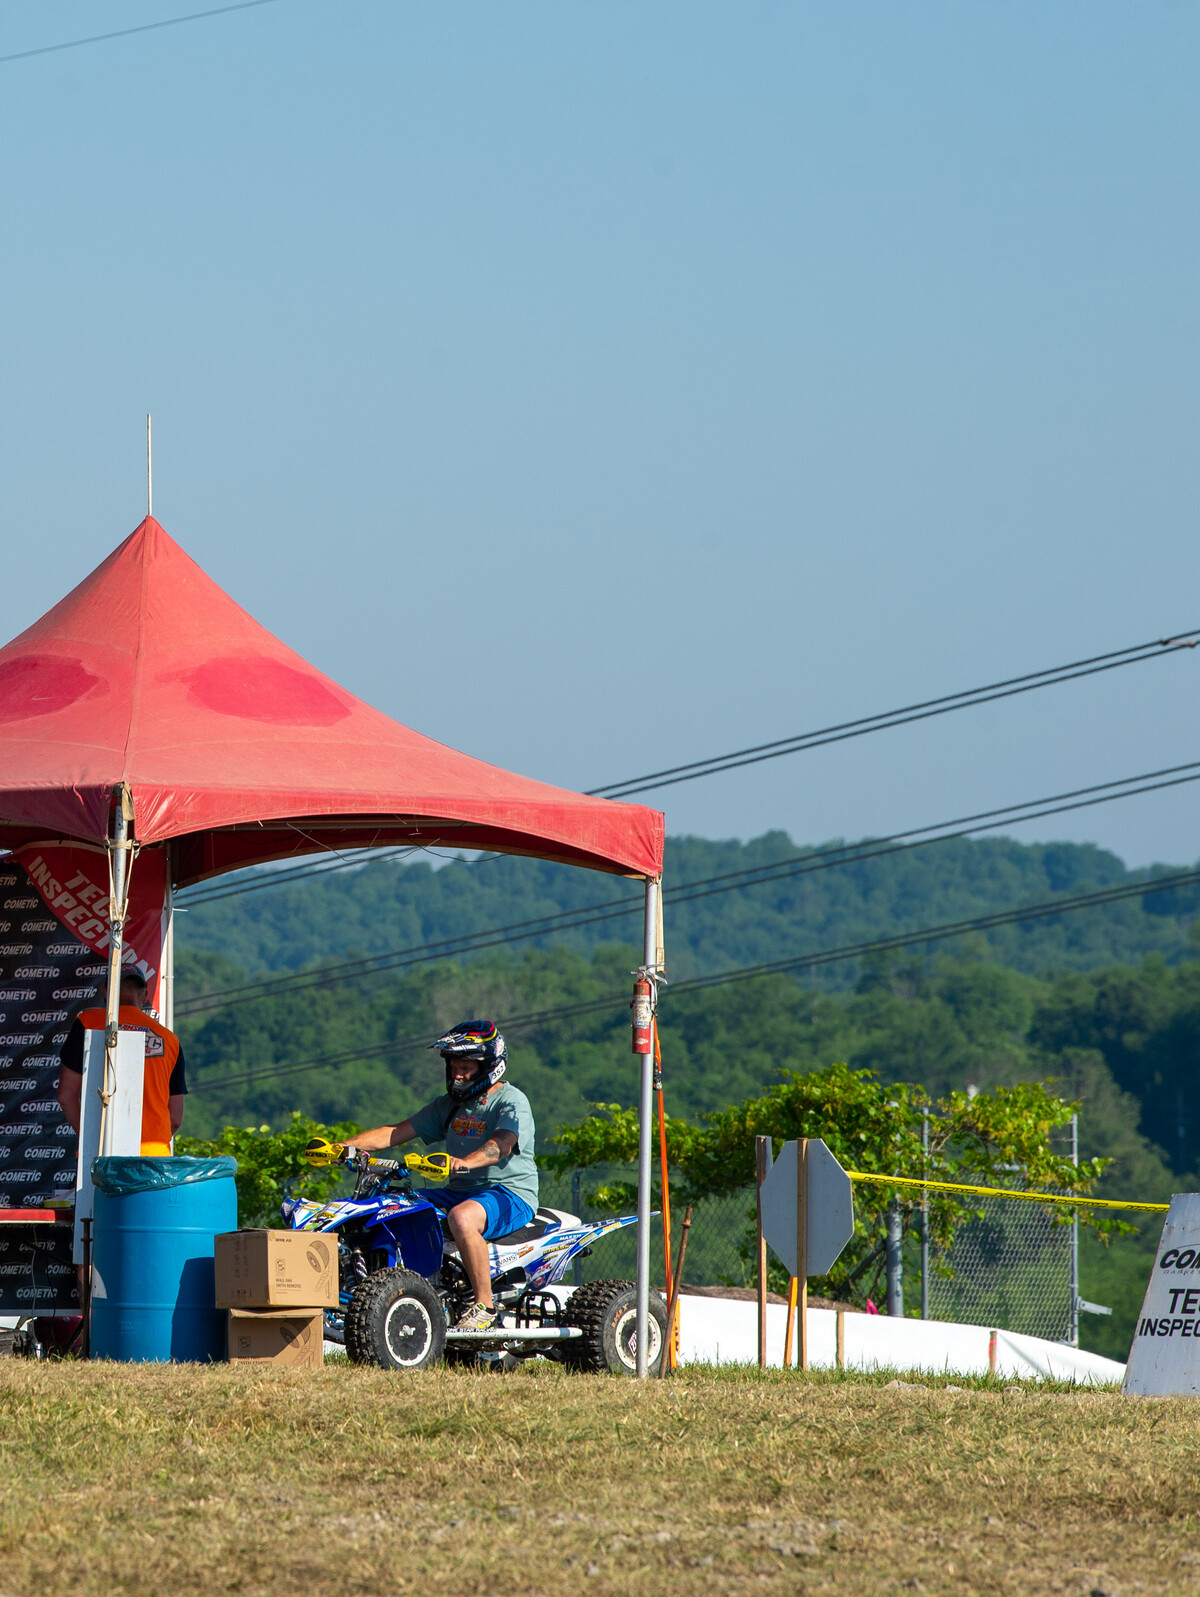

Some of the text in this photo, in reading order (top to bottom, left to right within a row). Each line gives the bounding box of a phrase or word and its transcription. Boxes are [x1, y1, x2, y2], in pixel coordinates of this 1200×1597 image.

[4, 897, 38, 909] COMETIC
[65, 870, 131, 926] TEC
[21, 921, 57, 932] COMETIC
[14, 967, 60, 978] COMETIC
[76, 967, 107, 976] COME
[52, 988, 97, 999] COMETIC
[21, 1012, 68, 1022] COMETIC
[0, 1034, 44, 1045] COMETIC
[22, 1056, 61, 1067] COMETIC
[21, 1102, 63, 1112] COMETI
[24, 1148, 66, 1158] COMETIC
[0, 1171, 41, 1182] COMETIC
[1168, 1289, 1200, 1314] TE
